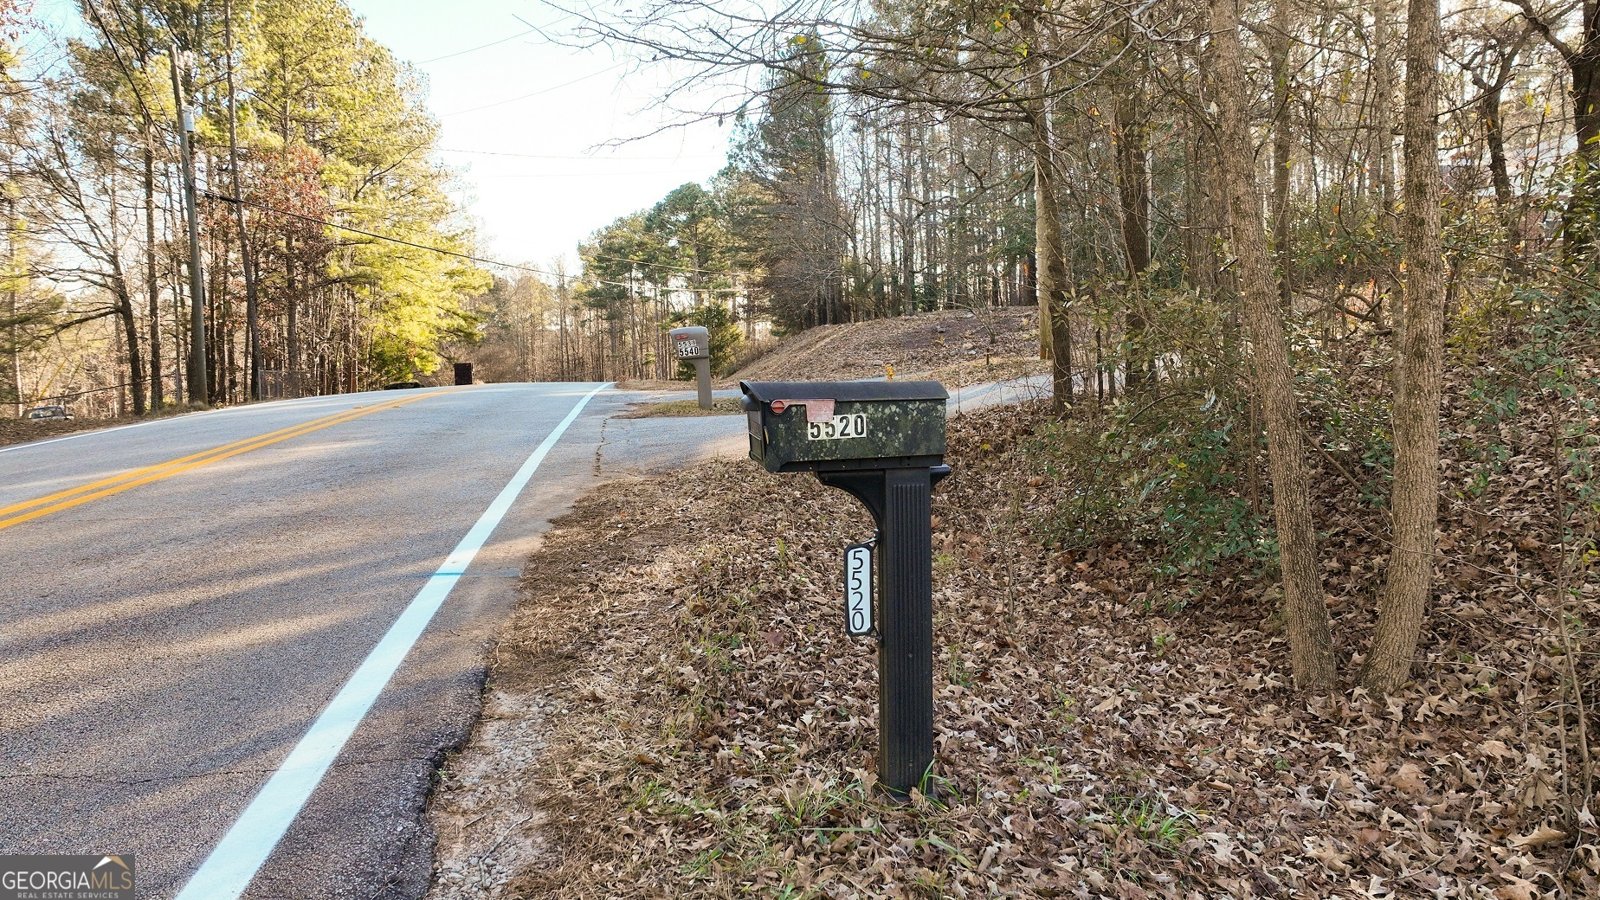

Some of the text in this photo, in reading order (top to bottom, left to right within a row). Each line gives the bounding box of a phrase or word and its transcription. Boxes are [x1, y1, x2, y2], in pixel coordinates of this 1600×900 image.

[680, 346, 699, 357] 5540
[810, 414, 865, 439] 5520
[851, 549, 865, 631] 5520
